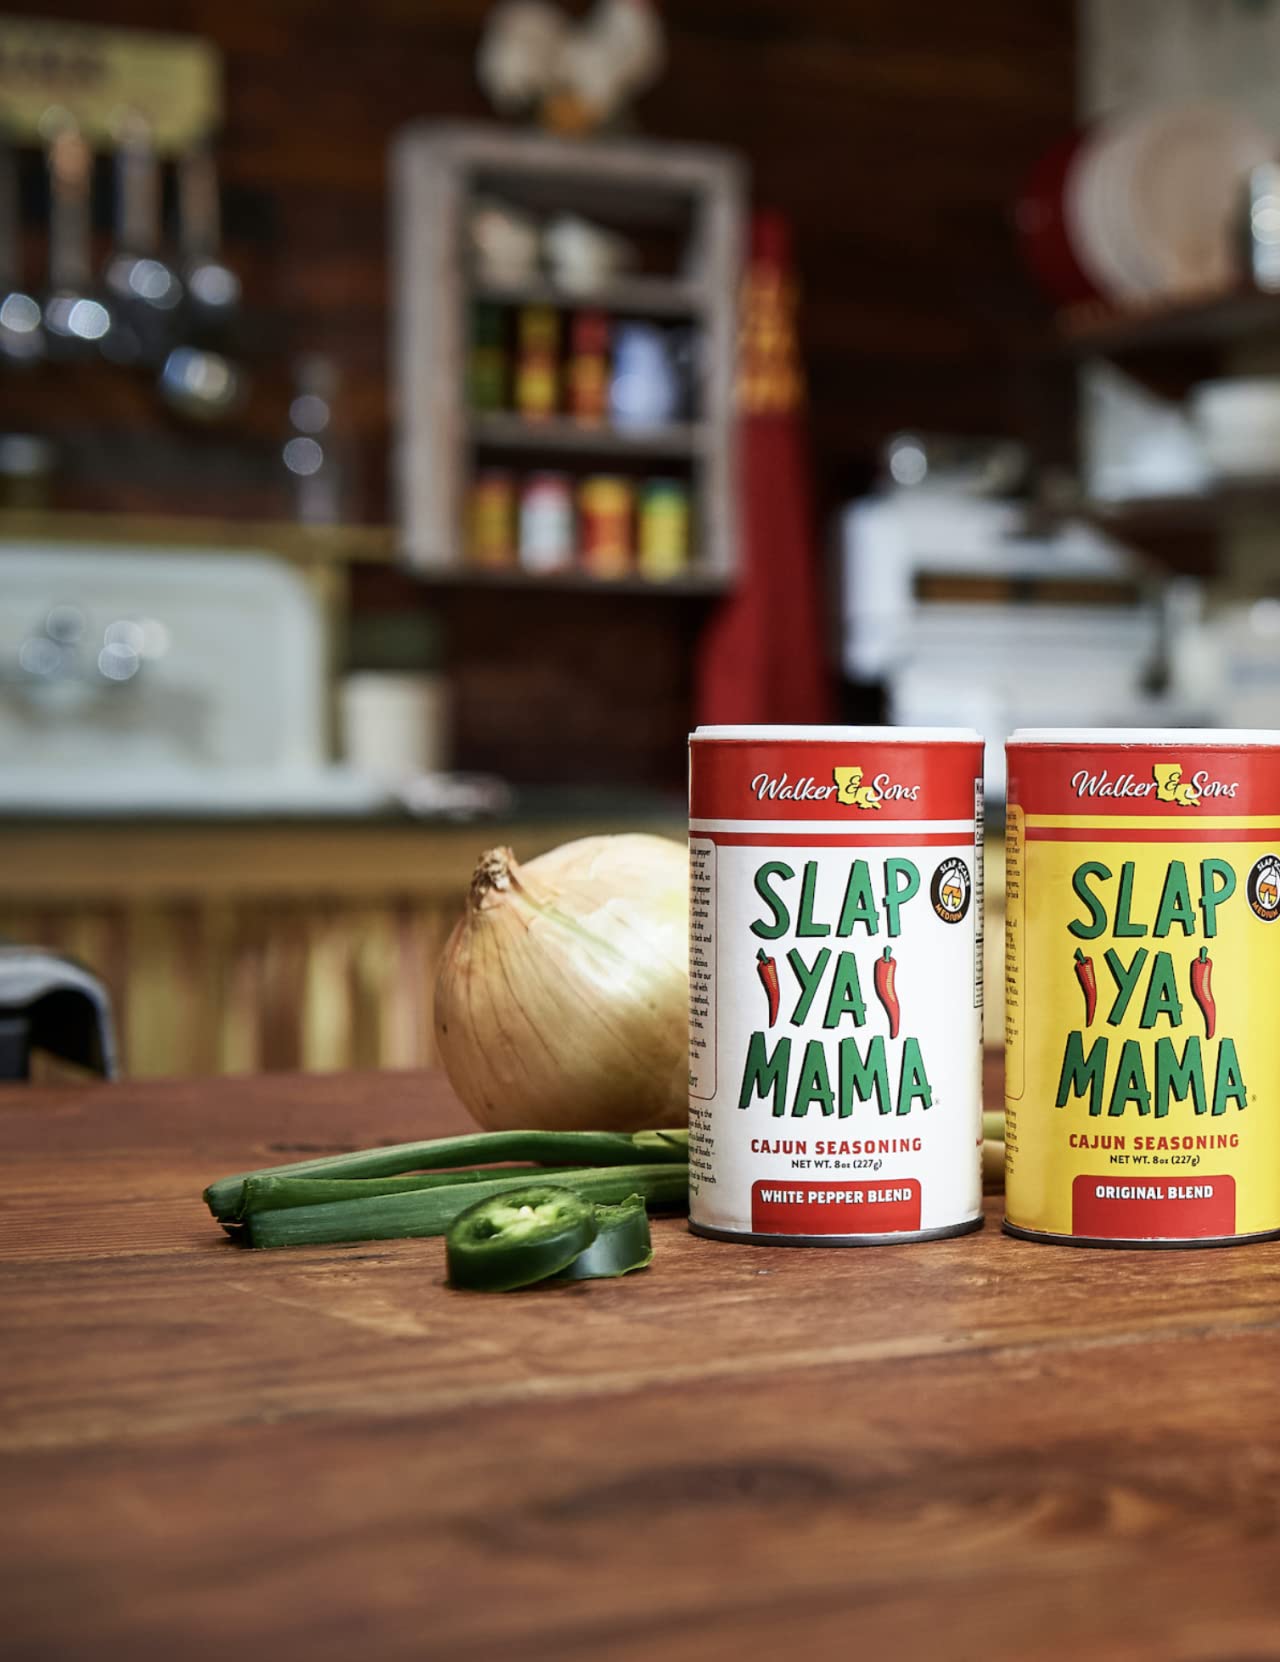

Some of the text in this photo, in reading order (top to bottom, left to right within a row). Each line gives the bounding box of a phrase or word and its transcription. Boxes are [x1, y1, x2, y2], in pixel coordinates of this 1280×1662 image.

[751, 773, 922, 801] Walker & Sons
[1070, 770, 1239, 798] Walker & Sons
[749, 857, 922, 940] SLAP
[1067, 858, 1237, 940] SLAP
[786, 947, 867, 1029] YA
[1104, 947, 1183, 1029] YA
[738, 1031, 933, 1119] MAMA
[1055, 1030, 1248, 1118] MAMA
[751, 1137, 922, 1155] CAJUN SEASONING
[1069, 1133, 1239, 1151] CAJUN SEASONING
[791, 1160, 812, 1169] NET
[814, 1160, 832, 1169] WT.
[853, 1159, 882, 1171] (227g)
[1110, 1155, 1130, 1165] NET
[1132, 1155, 1150, 1165] WT.
[1171, 1155, 1200, 1167] (227g)
[760, 1188, 912, 1204] WHITE PEPPER BLEND
[1095, 1185, 1214, 1200] ORIGINAL BLEND
